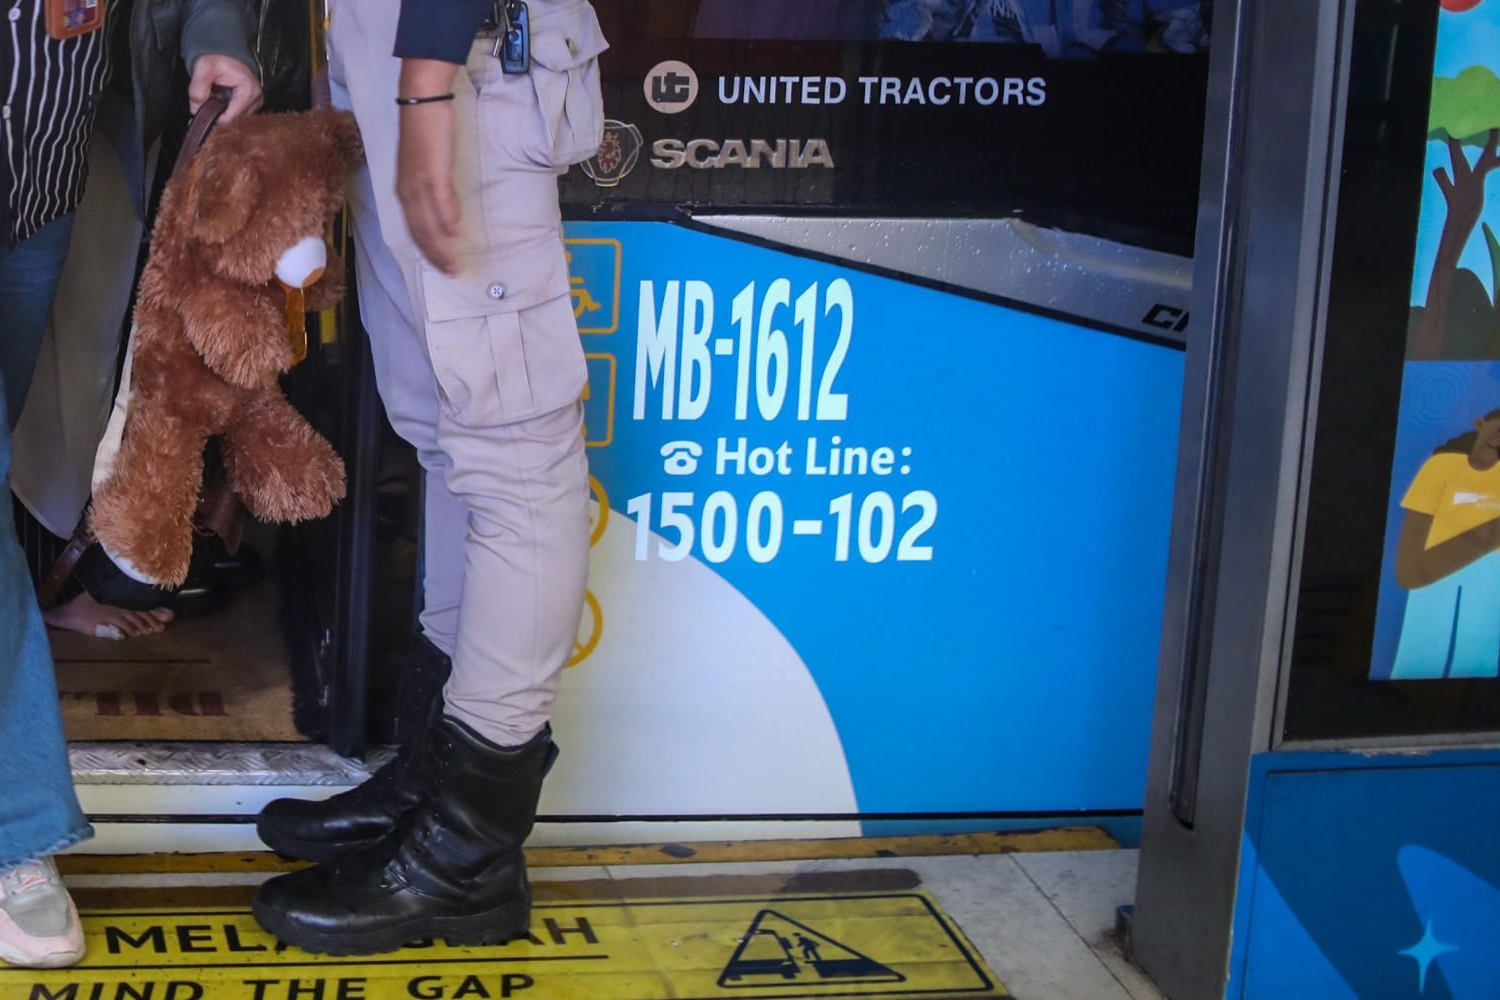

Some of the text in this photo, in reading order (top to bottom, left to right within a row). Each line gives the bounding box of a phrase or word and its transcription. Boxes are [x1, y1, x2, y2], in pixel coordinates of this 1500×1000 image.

[718, 76, 1047, 106] UNITED TRACTORS
[650, 138, 835, 169] SCANIA
[633, 278, 854, 421] MB-1612
[715, 435, 912, 476] Hot Line:
[627, 490, 938, 563] 1500-102
[28, 980, 204, 1000] MIND
[243, 977, 367, 1000] THE
[406, 973, 535, 1000] GAP
